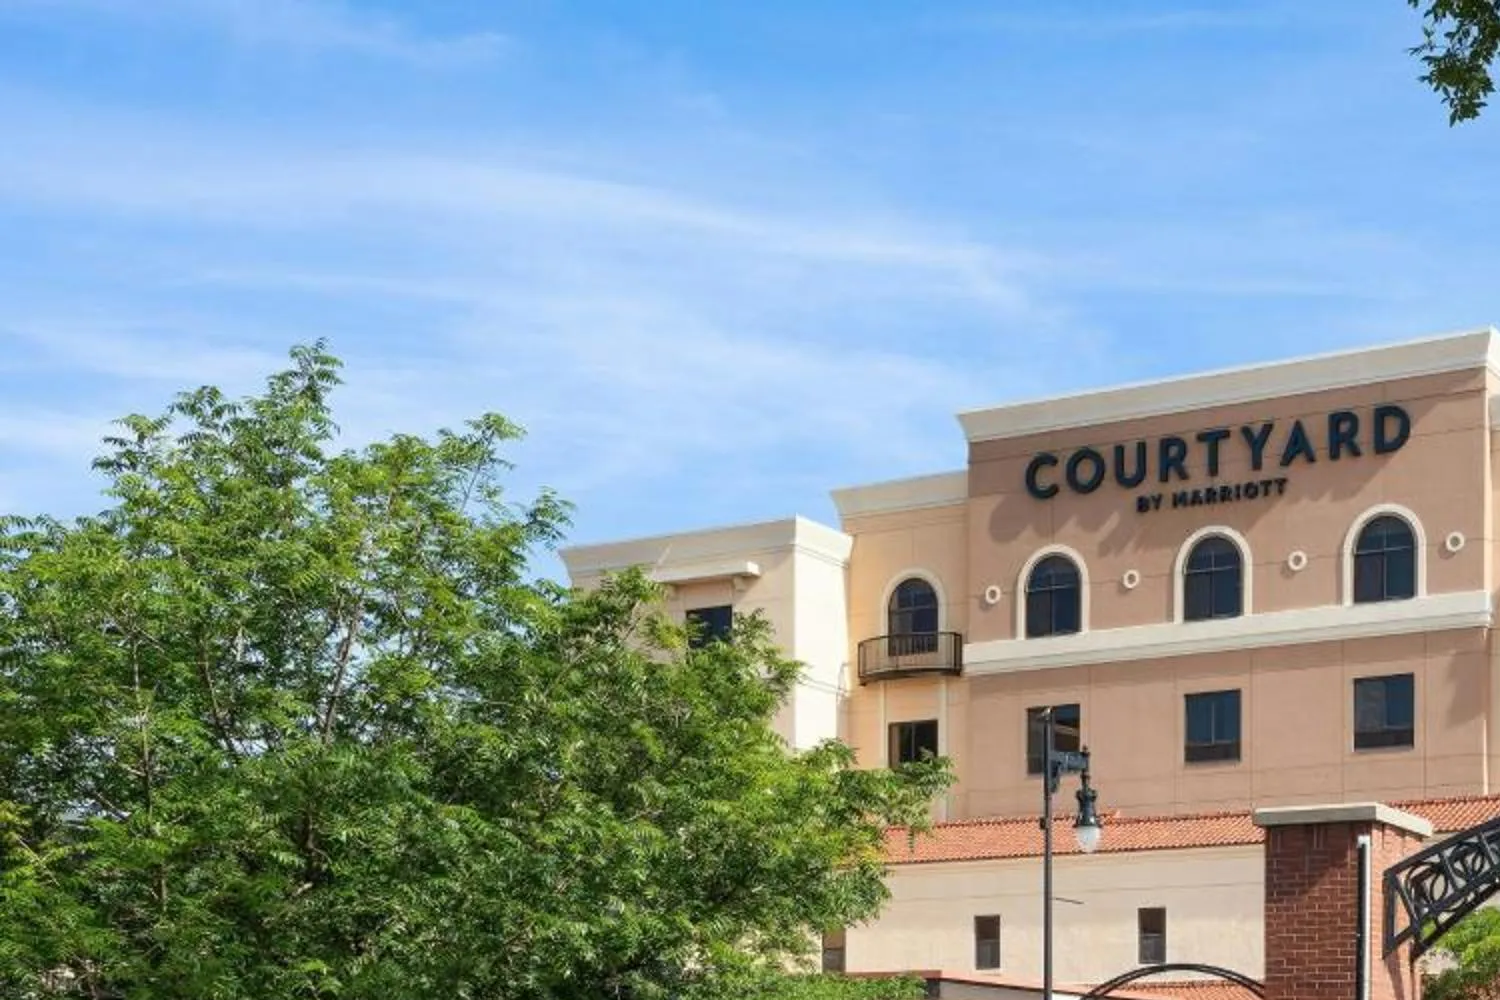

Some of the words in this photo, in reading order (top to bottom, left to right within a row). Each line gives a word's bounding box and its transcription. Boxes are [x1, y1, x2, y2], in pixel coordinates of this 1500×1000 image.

[1025, 405, 1411, 500] COURTYARD
[1136, 495, 1163, 513] BY
[1173, 477, 1288, 509] MARRIOTT
